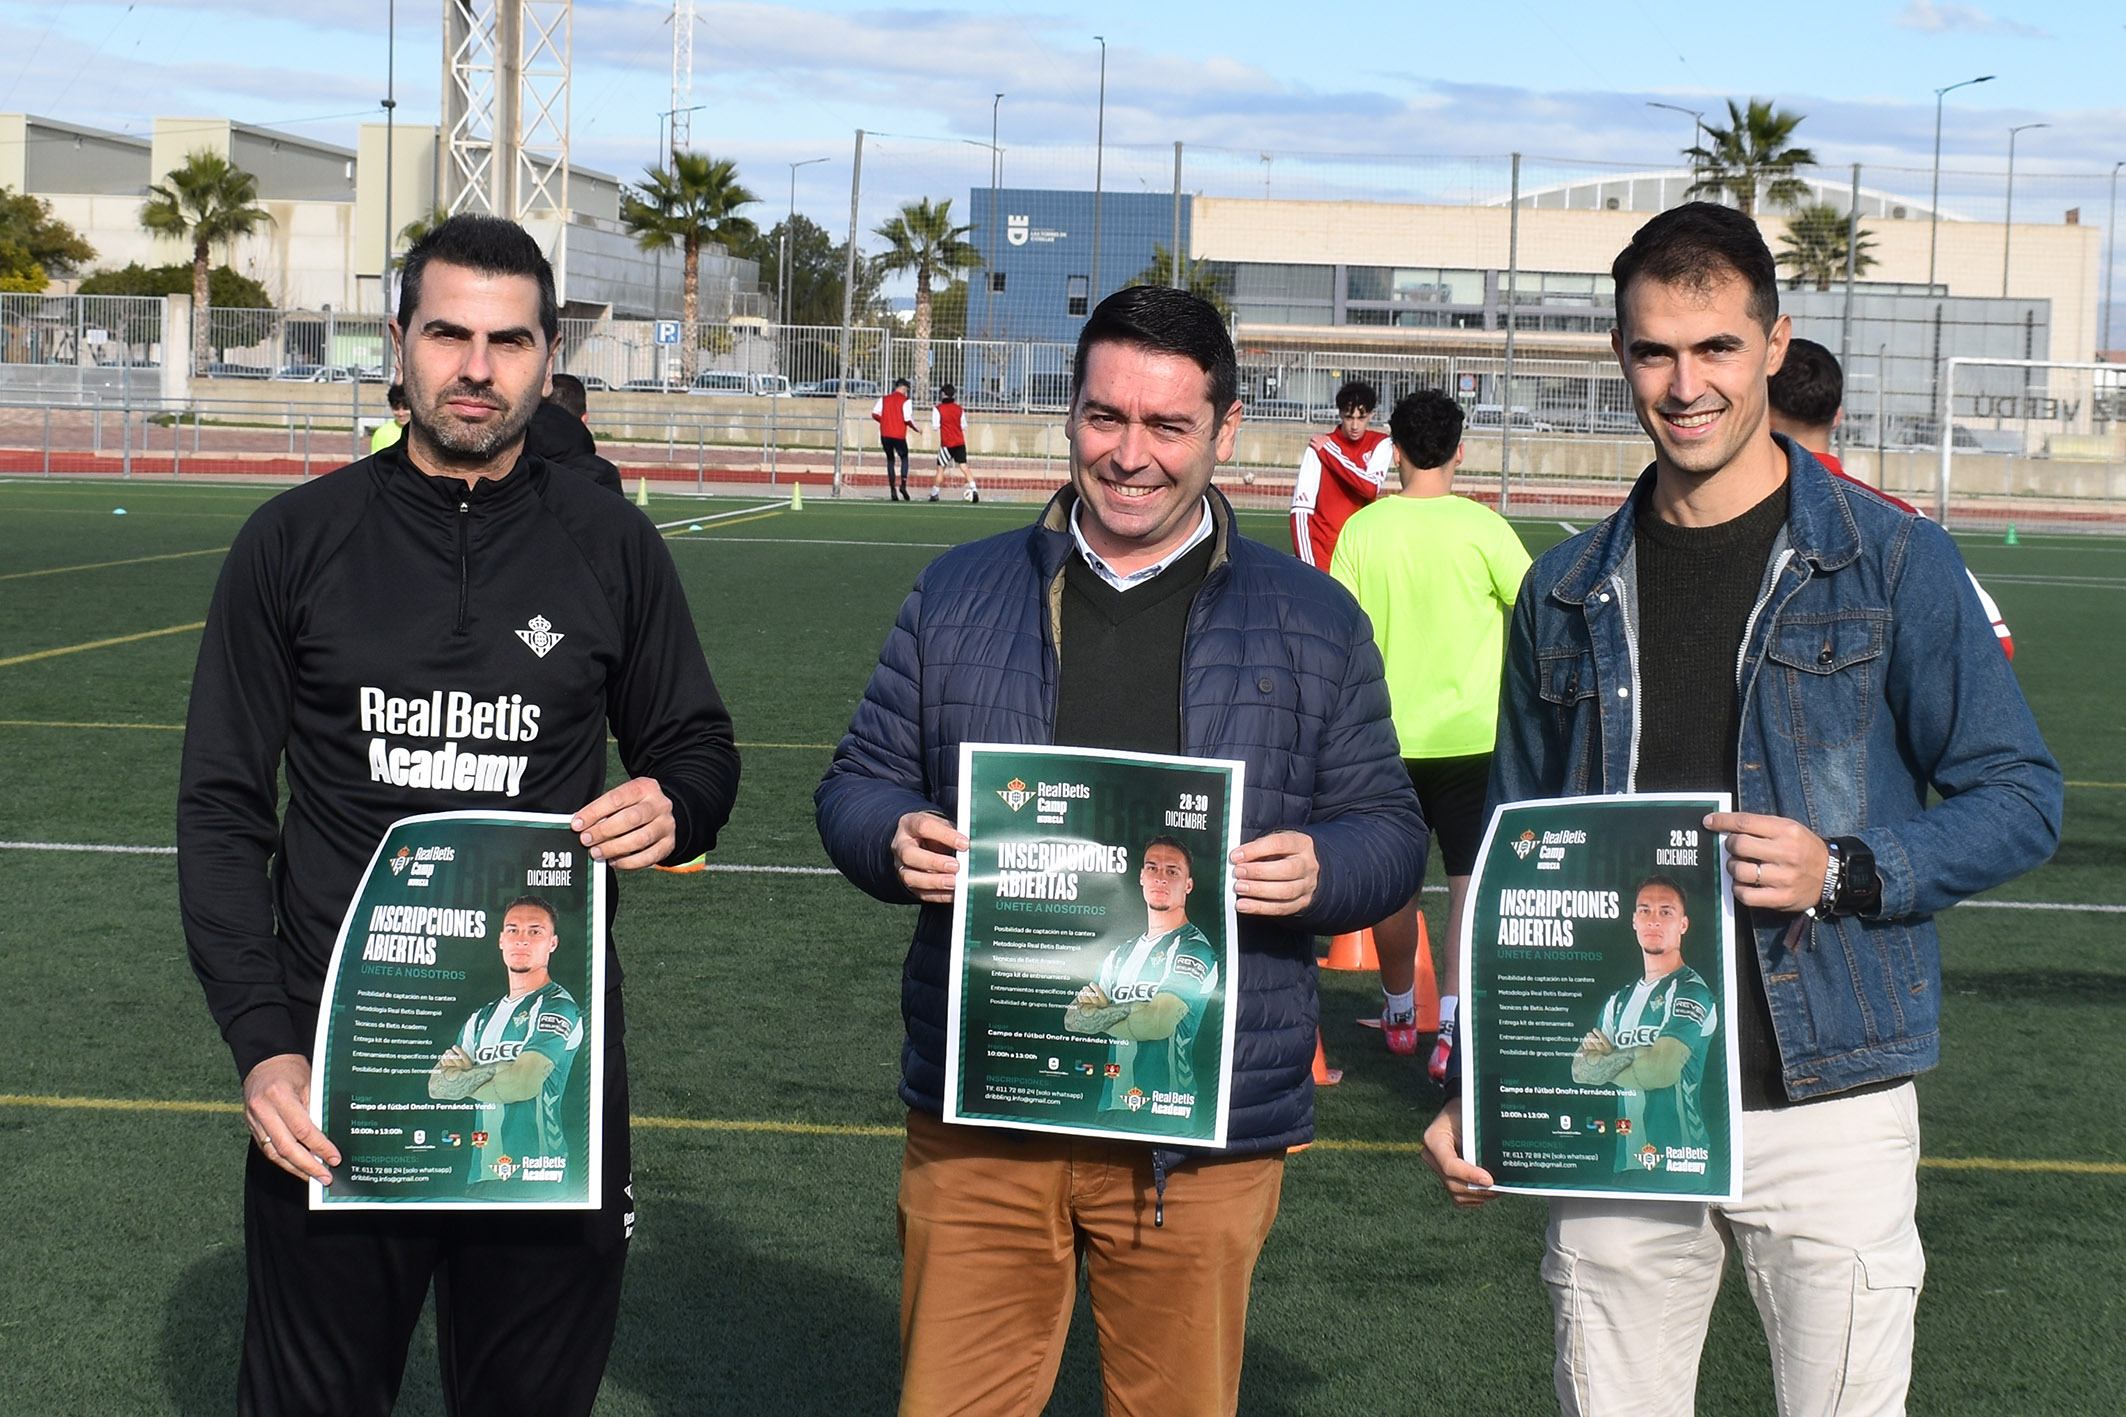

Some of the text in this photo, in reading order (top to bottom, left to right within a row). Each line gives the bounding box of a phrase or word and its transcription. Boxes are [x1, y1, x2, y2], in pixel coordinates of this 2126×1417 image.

[660, 323, 675, 342] P
[359, 686, 541, 742] Real Betis
[368, 737, 528, 797] Academy
[1037, 781, 1090, 799] Real Betis
[1036, 797, 1068, 815] Camp
[1179, 793, 1208, 812] 28-30
[1165, 810, 1207, 831] DICIEMBRE
[1542, 830, 1587, 845] Real Betis
[1670, 829, 1698, 847] 28-30
[414, 846, 456, 861] Real Betis
[541, 851, 572, 868] 28-30
[997, 842, 1128, 874] INSCRIPCIONES
[1539, 845, 1566, 862] Camp
[1656, 848, 1698, 866] DICIEMBRE
[410, 862, 435, 877] Camp
[526, 869, 572, 886] DICIEMBRE
[996, 869, 1079, 901] ABIERTAS
[995, 900, 1106, 916] ÚNETE A NOSOTROS
[1499, 888, 1620, 919] INSCRIPCIONES
[369, 904, 487, 939] INSCRIPCIONES
[994, 925, 1025, 934] Posibilidad
[1032, 928, 1060, 936] captación
[1497, 918, 1574, 947] ABIERTAS
[362, 932, 437, 966] ABIERTAS
[992, 940, 1026, 949] Metodología
[1497, 948, 1603, 961] ÚNETE A NOSOTROS
[361, 964, 466, 981] ÚNETE A NOSOTROS
[991, 970, 1071, 981] Entrega entrenamiento
[1497, 974, 1526, 982] Posibilidad
[990, 985, 1034, 994] Entrenamientos
[1544, 1005, 1569, 1013] Academy
[401, 1023, 428, 1031] Academy
[1498, 1019, 1519, 1027] Entrega
[1535, 1020, 1574, 1028] entrenamiento
[353, 1034, 433, 1046] Entrega entrenamiento
[987, 1029, 1013, 1039] Campo
[1046, 1033, 1070, 1042] Onofre
[1070, 1035, 1108, 1044] Fernández
[1109, 1037, 1129, 1046] Verdú
[352, 1050, 397, 1060] Entrenamientos
[987, 1050, 1010, 1058] 10:00h
[984, 1092, 1061, 1105] dribbling.info@gmail.com
[1036, 1088, 1051, 1097] (solo
[1052, 1090, 1083, 1100] whatsapp)
[1152, 1090, 1195, 1106] Real Betis
[1500, 1085, 1524, 1094] Campo
[1524, 1086, 1533, 1094] de
[1534, 1085, 1554, 1094] fútbol
[1555, 1087, 1579, 1095] Onofre
[1579, 1087, 1616, 1097] Fernández
[350, 1102, 376, 1111] Campo
[387, 1102, 410, 1110] fútbol
[410, 1102, 435, 1110] Onofre
[436, 1102, 474, 1110] Fernández
[1151, 1102, 1192, 1118] Academy
[1500, 1111, 1523, 1119] 10:00h
[350, 1127, 374, 1135] 10:00h
[1567, 1153, 1599, 1161] whatsapp)
[1665, 1146, 1709, 1160] Real Betis
[522, 1156, 567, 1169] Real Betis
[1665, 1159, 1706, 1175] Academy
[375, 1166, 383, 1174] 72
[403, 1166, 419, 1175] (solo
[419, 1166, 452, 1175] whatsapp)
[521, 1168, 564, 1183] Academy
